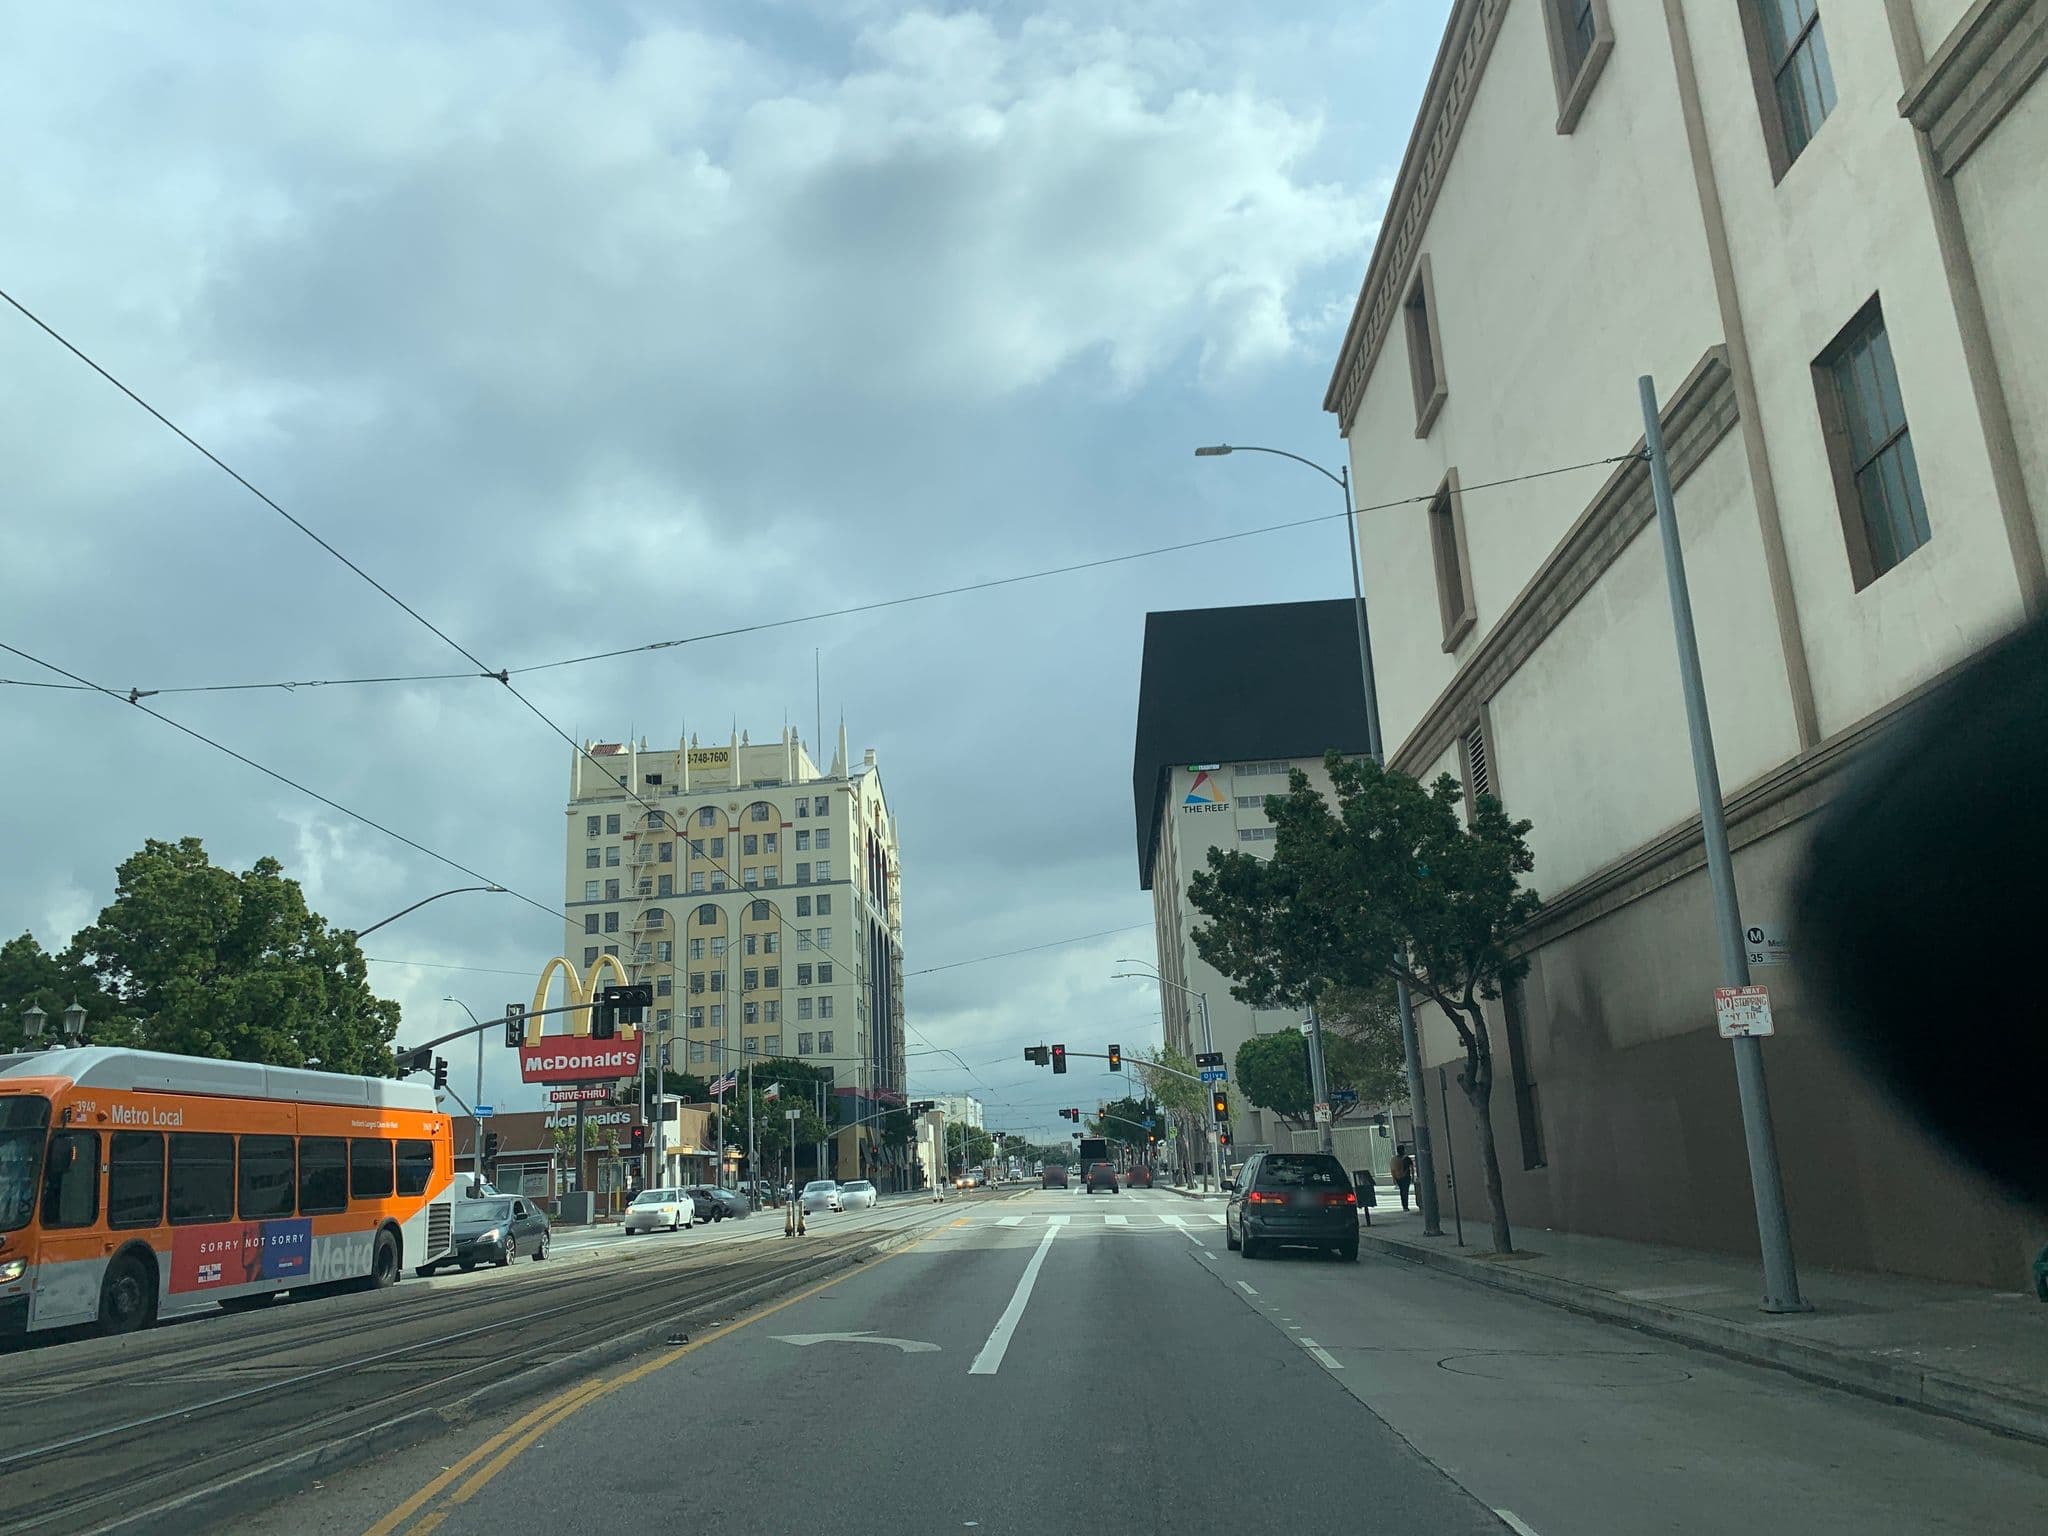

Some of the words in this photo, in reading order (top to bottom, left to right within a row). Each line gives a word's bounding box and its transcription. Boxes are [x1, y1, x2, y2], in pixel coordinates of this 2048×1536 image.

[1182, 805, 1203, 813] THE
[1205, 803, 1230, 813] REEF
[1750, 953, 1764, 963] 35
[1716, 997, 1733, 1012] NO
[525, 1051, 636, 1072] McDonald's
[552, 1089, 606, 1101] DRIVE-THRU
[77, 1100, 97, 1113] 3949
[111, 1104, 149, 1124] Metro
[152, 1107, 183, 1126] Local
[544, 1111, 631, 1129] McDnald's
[200, 1239, 239, 1254] SORRY
[245, 1236, 266, 1248] NOT
[271, 1233, 305, 1246] SORRY
[311, 1237, 373, 1282] Metro
